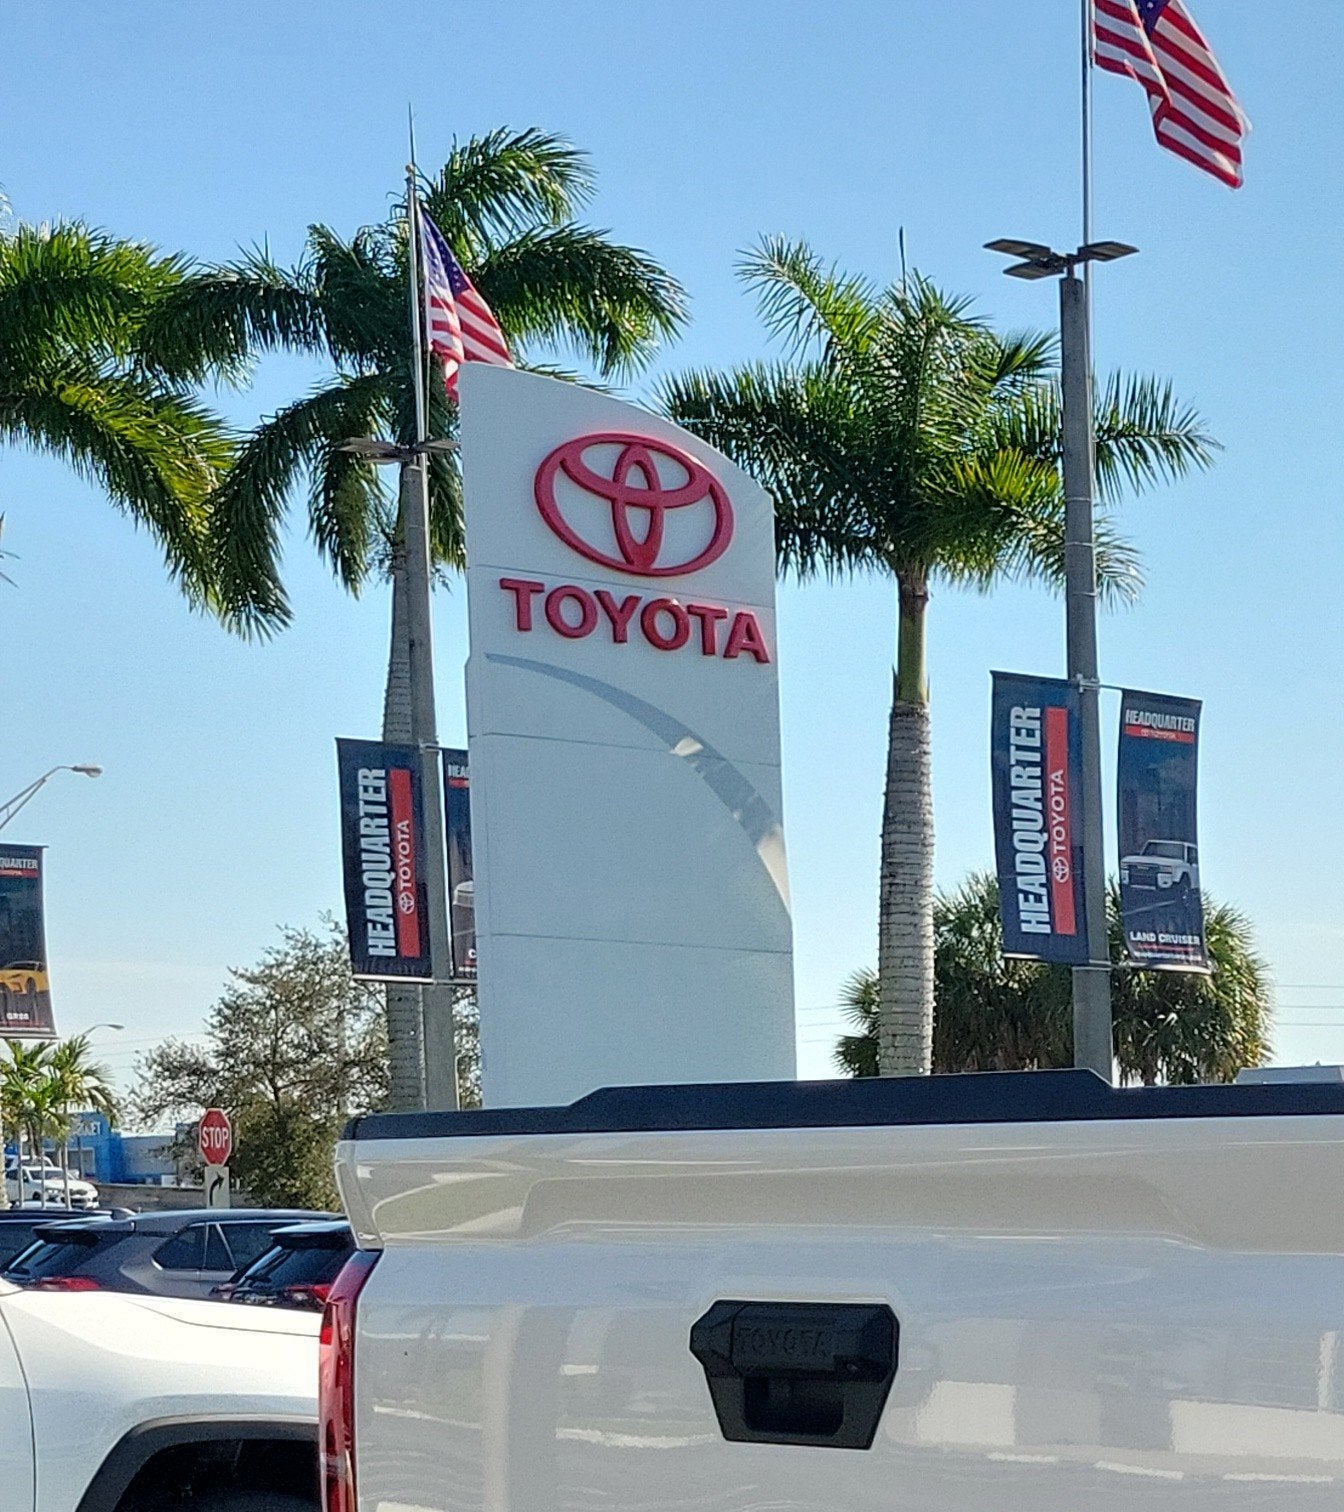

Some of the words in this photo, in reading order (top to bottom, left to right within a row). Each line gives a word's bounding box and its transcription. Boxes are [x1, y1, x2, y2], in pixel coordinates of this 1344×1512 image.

[499, 577, 771, 664] TOYOTA
[1125, 709, 1195, 733] HEADQUARTER
[1009, 705, 1052, 934] HEADQUARTER
[1051, 769, 1067, 854] TOYOTA
[358, 767, 397, 958] HEADQUARTER
[397, 820, 415, 890] TOYOTA
[1129, 931, 1157, 942] LAND
[1158, 934, 1201, 945] CRUISER
[201, 1127, 229, 1149] STOP
